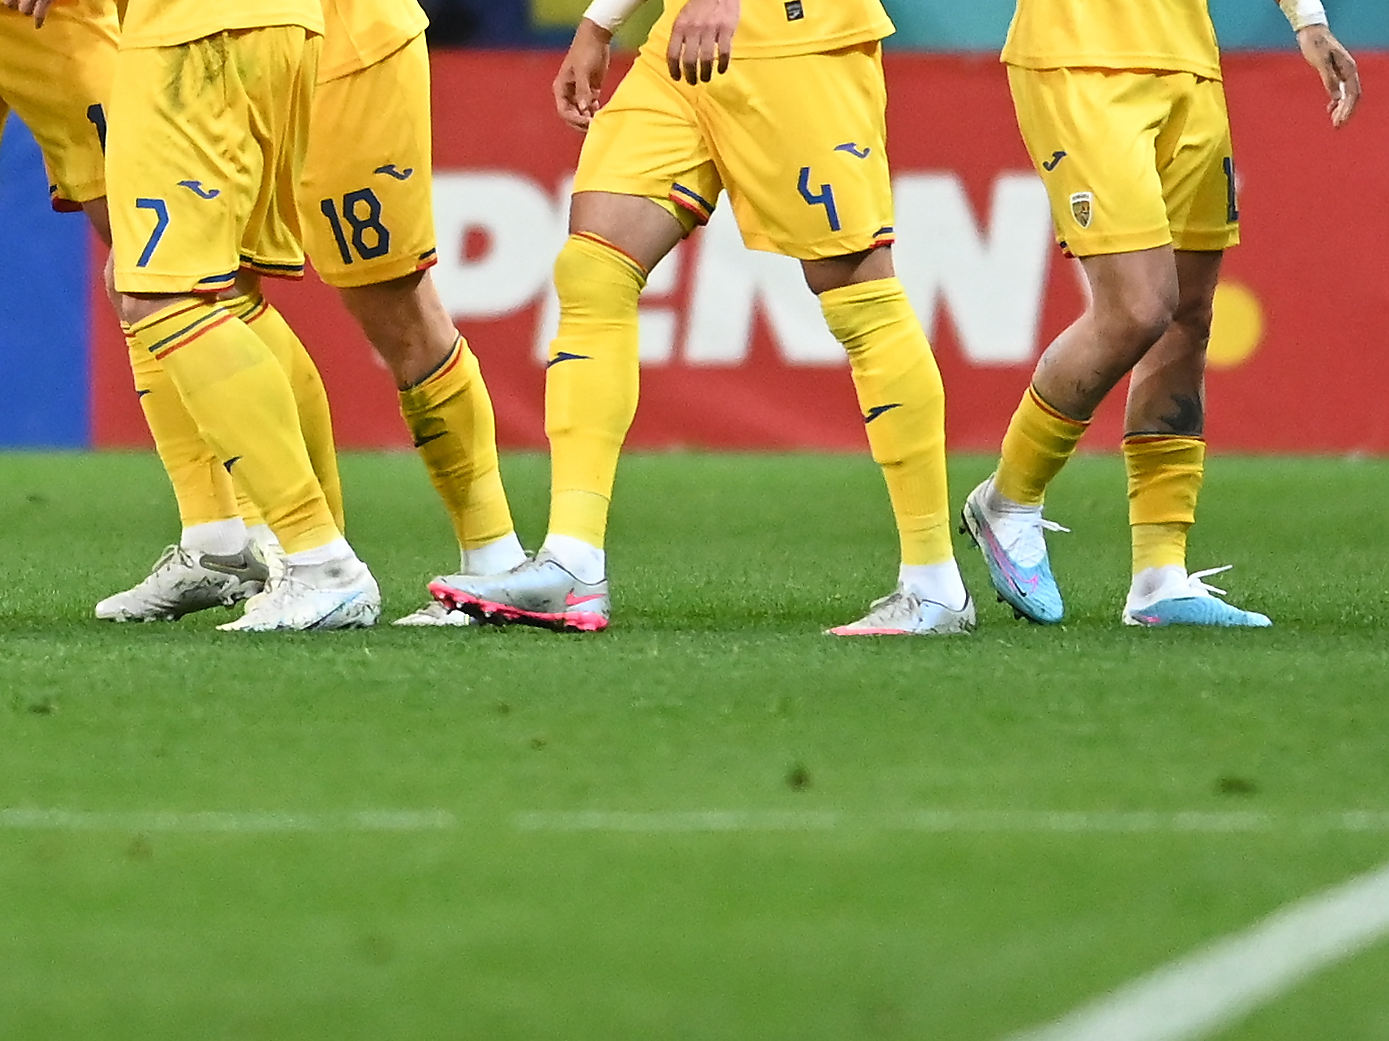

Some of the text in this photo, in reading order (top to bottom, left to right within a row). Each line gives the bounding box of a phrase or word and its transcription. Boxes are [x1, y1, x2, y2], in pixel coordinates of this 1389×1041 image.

[135, 197, 170, 268] 7
[320, 187, 391, 265] 18
[796, 166, 841, 233] 4
